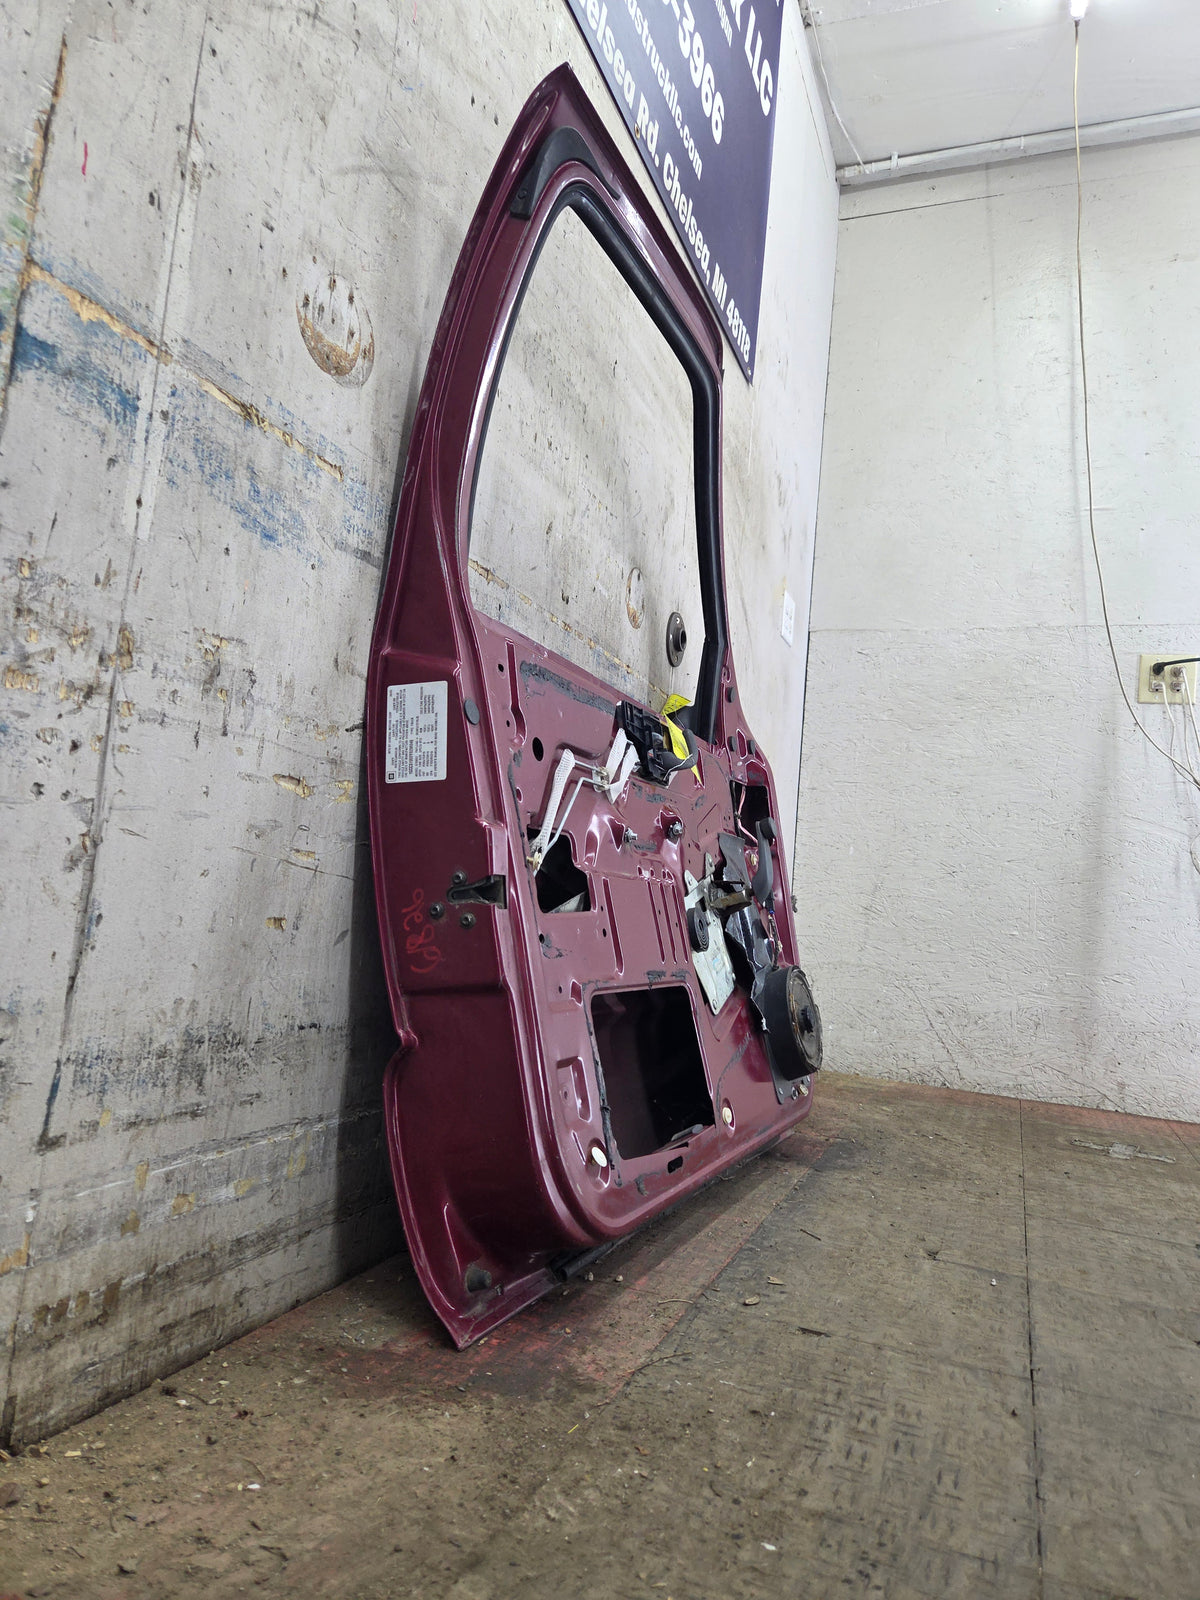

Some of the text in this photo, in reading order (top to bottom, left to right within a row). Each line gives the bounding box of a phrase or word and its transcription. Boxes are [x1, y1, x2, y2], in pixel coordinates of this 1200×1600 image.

[624, 0, 703, 180] astruckllc.com
[744, 5, 773, 117] LLC
[579, 0, 751, 363] elsea Rd. Chelsea, MI 48118
